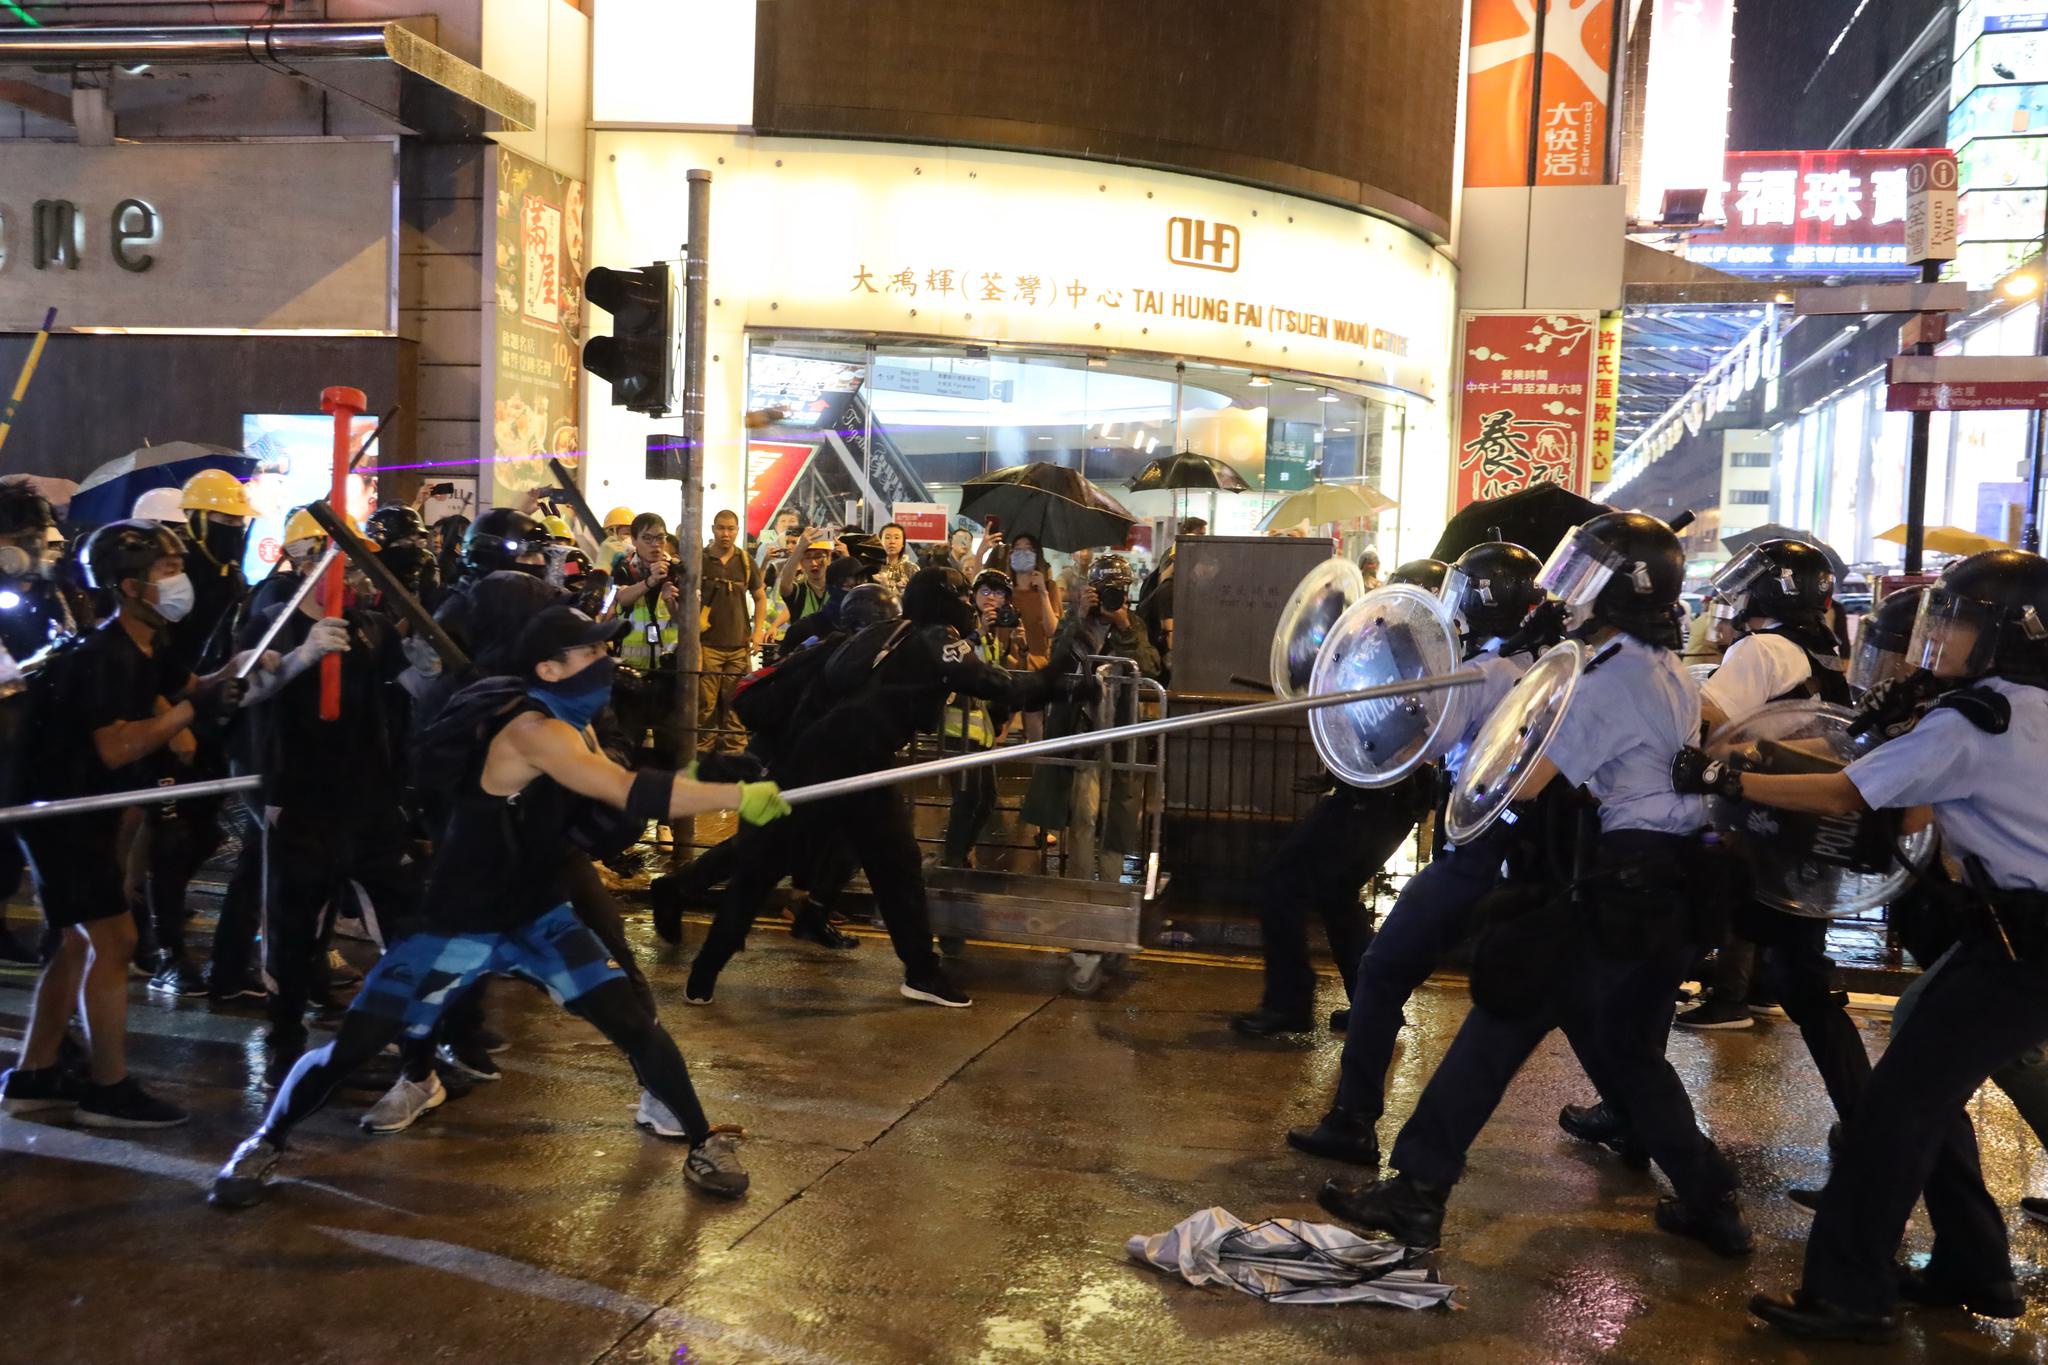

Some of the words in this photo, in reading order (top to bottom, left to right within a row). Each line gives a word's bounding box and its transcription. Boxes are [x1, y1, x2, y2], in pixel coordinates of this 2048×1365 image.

[1543, 101, 1580, 176] 大快活
[1579, 101, 1593, 176] Fairwood
[0, 198, 158, 273] me
[1930, 200, 1943, 250] Tsuen
[1942, 207, 1954, 242] Wan
[850, 264, 1122, 310] 大鴻輝(荃灣)中心
[1132, 289, 1164, 315] TAI
[1171, 293, 1228, 323] HUNG
[1234, 302, 1262, 328] FAI
[1267, 305, 1328, 338] (TSUEN
[1332, 318, 1369, 349] WAN)
[552, 341, 577, 389] 10/F
[1466, 382, 1583, 395] 中午十二時至凌晨六時
[1501, 369, 1548, 380] 營業時間
[1593, 330, 1616, 470] 許氏匯款中心
[1985, 397, 2002, 406] Old
[2004, 397, 2036, 406] House
